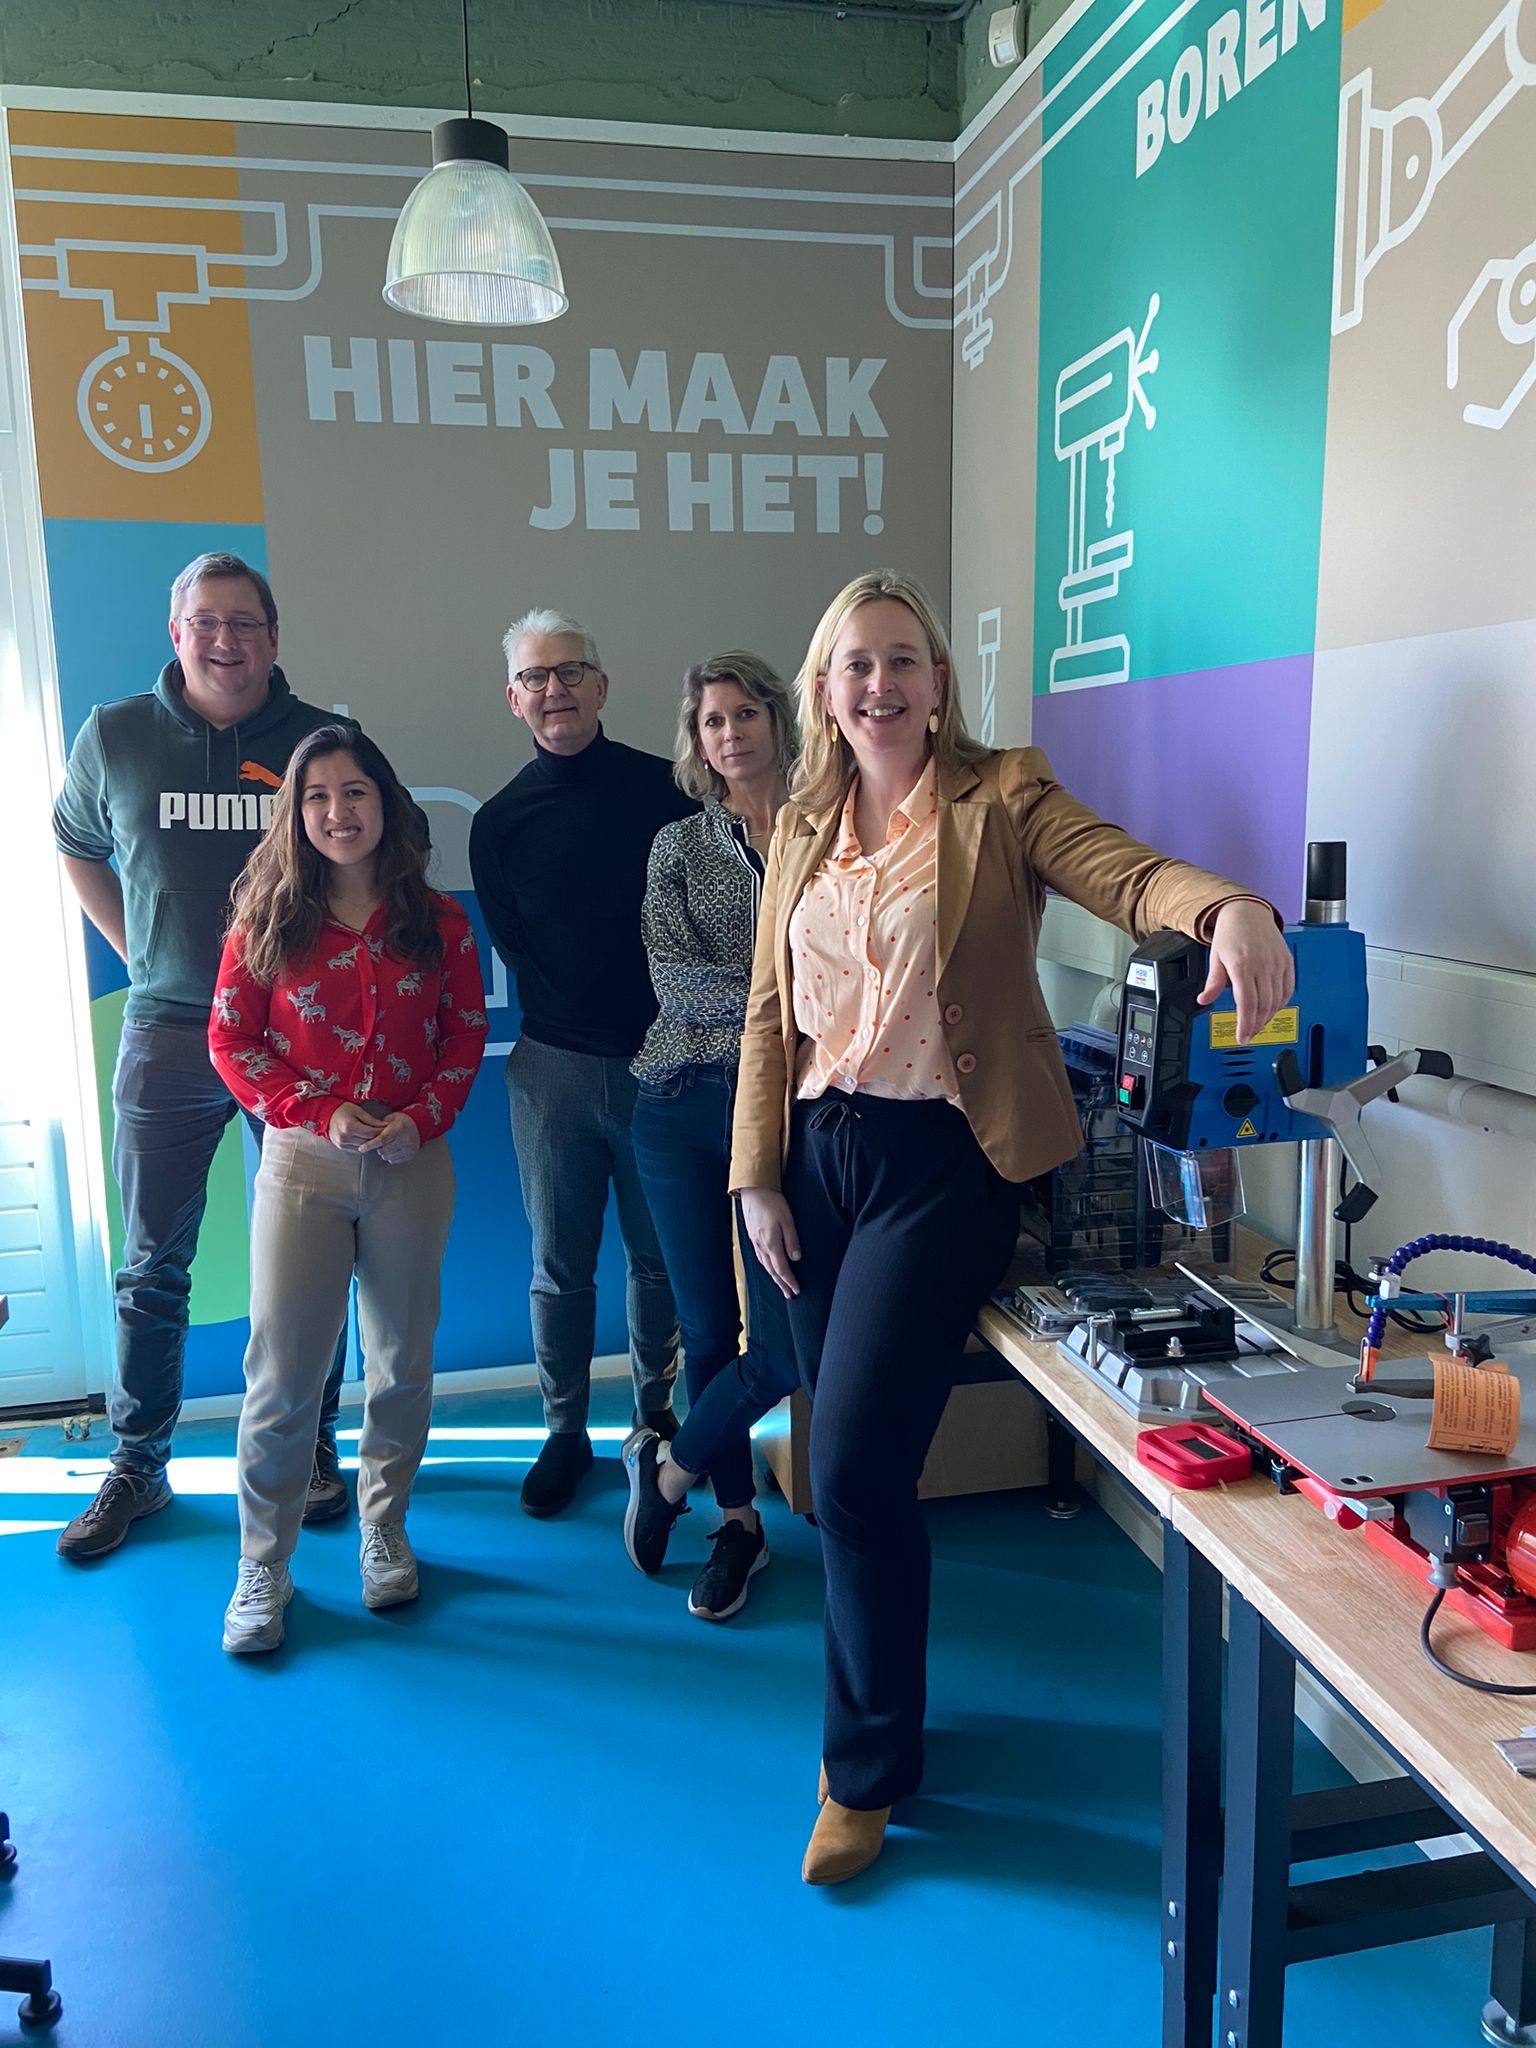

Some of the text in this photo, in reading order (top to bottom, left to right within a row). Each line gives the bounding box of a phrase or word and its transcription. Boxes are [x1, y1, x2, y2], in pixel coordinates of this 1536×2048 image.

[303, 335, 889, 438] HIER MAAK
[528, 448, 885, 536] JE HET!
